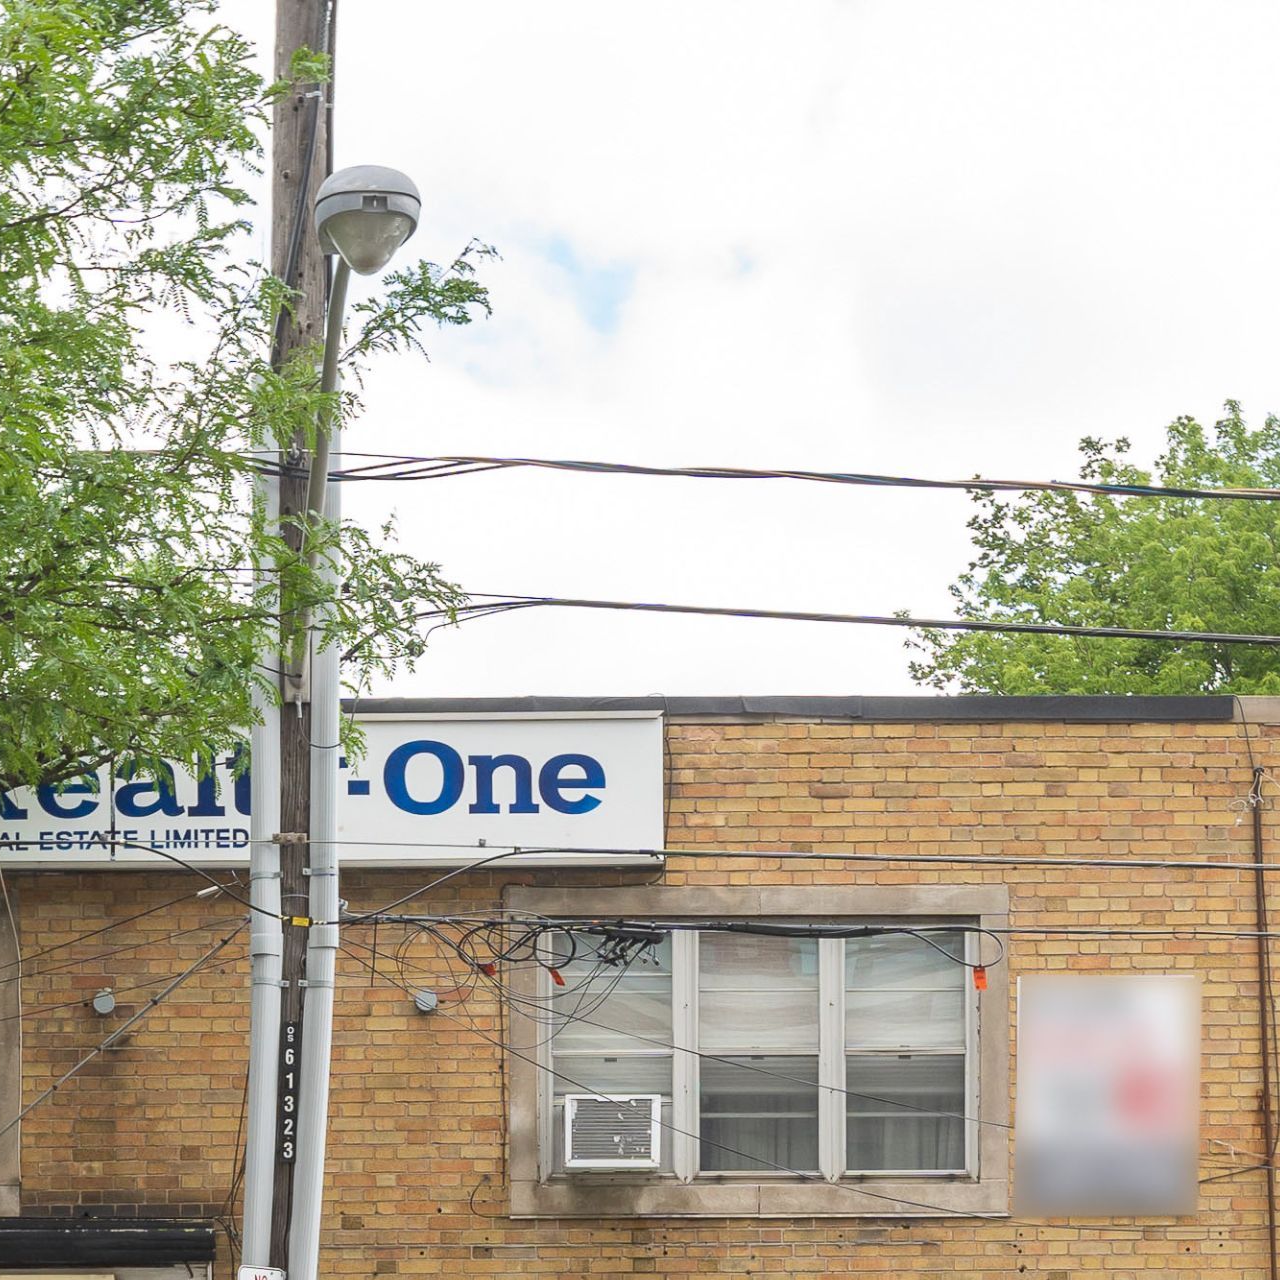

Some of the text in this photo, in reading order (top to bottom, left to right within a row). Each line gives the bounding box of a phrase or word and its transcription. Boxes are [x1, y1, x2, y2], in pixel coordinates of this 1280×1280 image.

[39, 830, 138, 851] ESTATE
[150, 828, 250, 850] LIMITED
[283, 1049, 295, 1158] 61323
